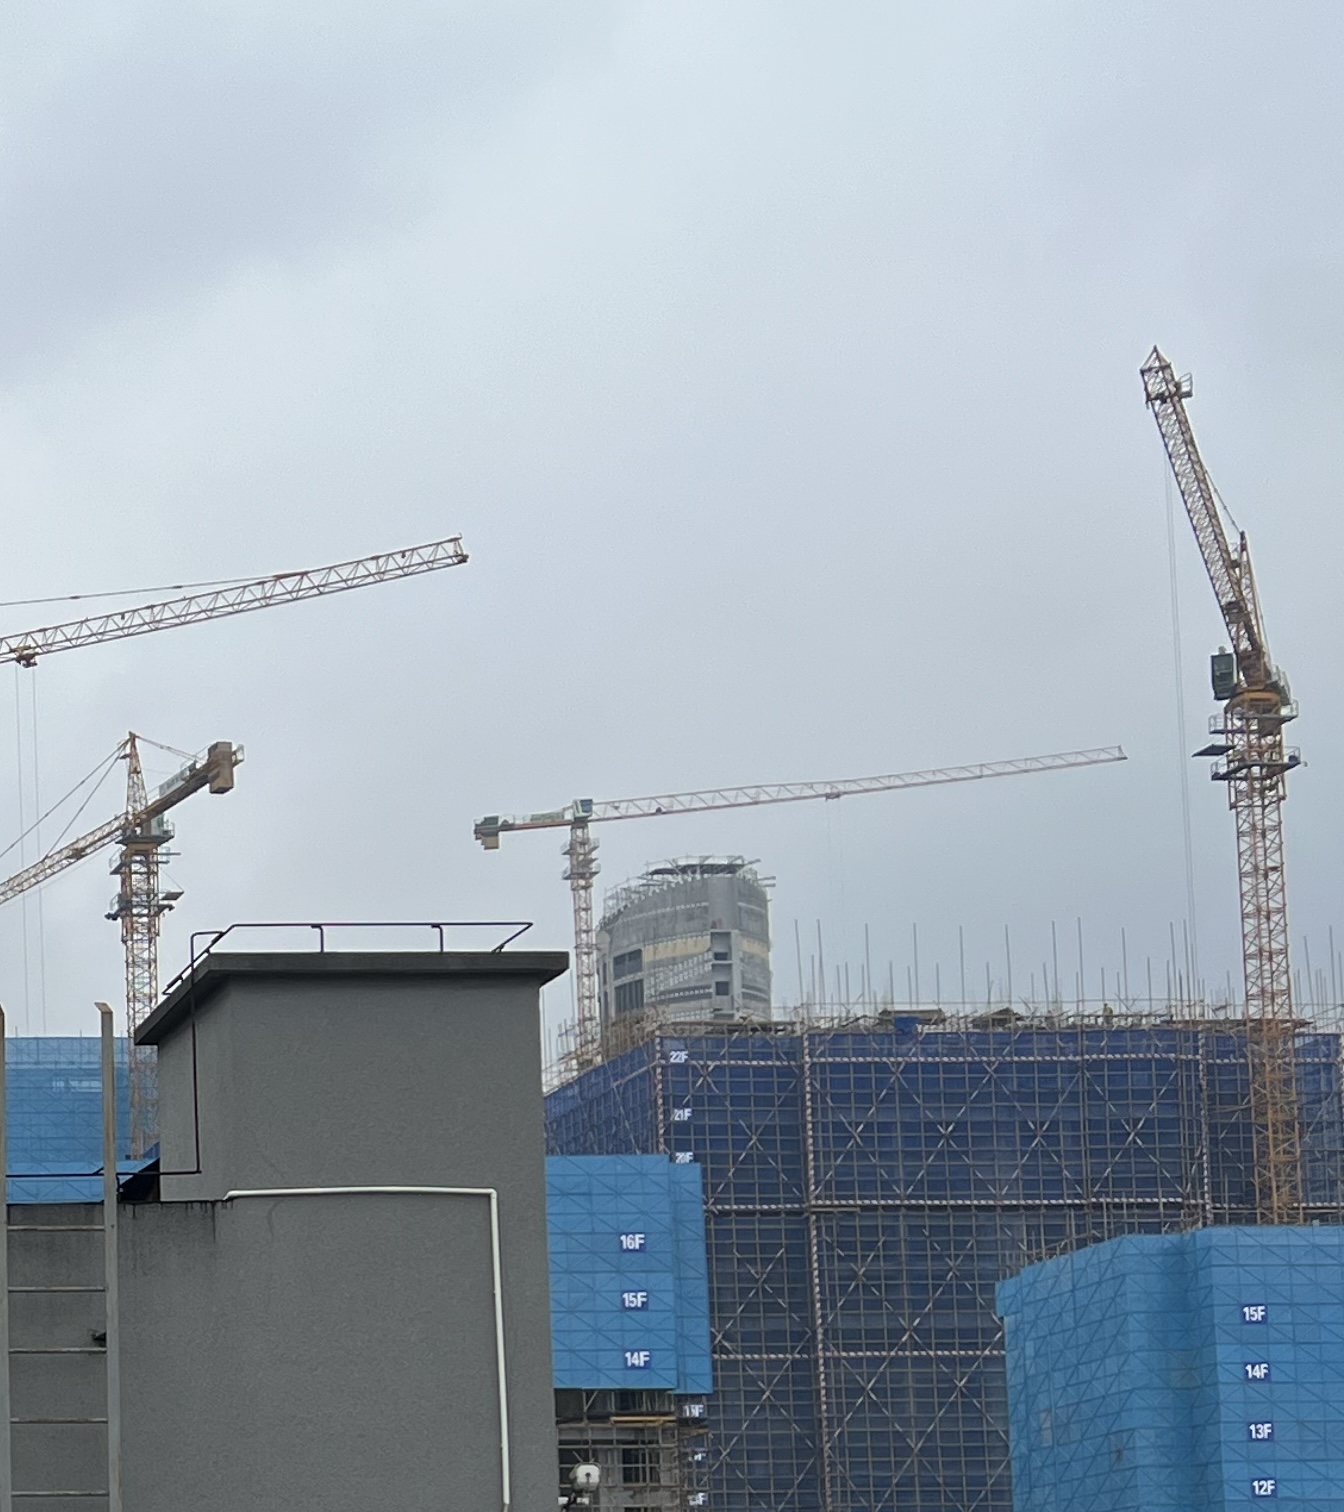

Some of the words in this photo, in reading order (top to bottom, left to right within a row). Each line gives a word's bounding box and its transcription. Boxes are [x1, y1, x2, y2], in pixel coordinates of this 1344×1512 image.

[620, 1234, 645, 1250] 16F
[622, 1292, 647, 1308] 15F
[1243, 1306, 1266, 1321] 15F
[624, 1351, 650, 1367] 14F
[1245, 1363, 1269, 1379] 14F
[1249, 1423, 1272, 1439] 13F
[1252, 1480, 1275, 1495] 12F
